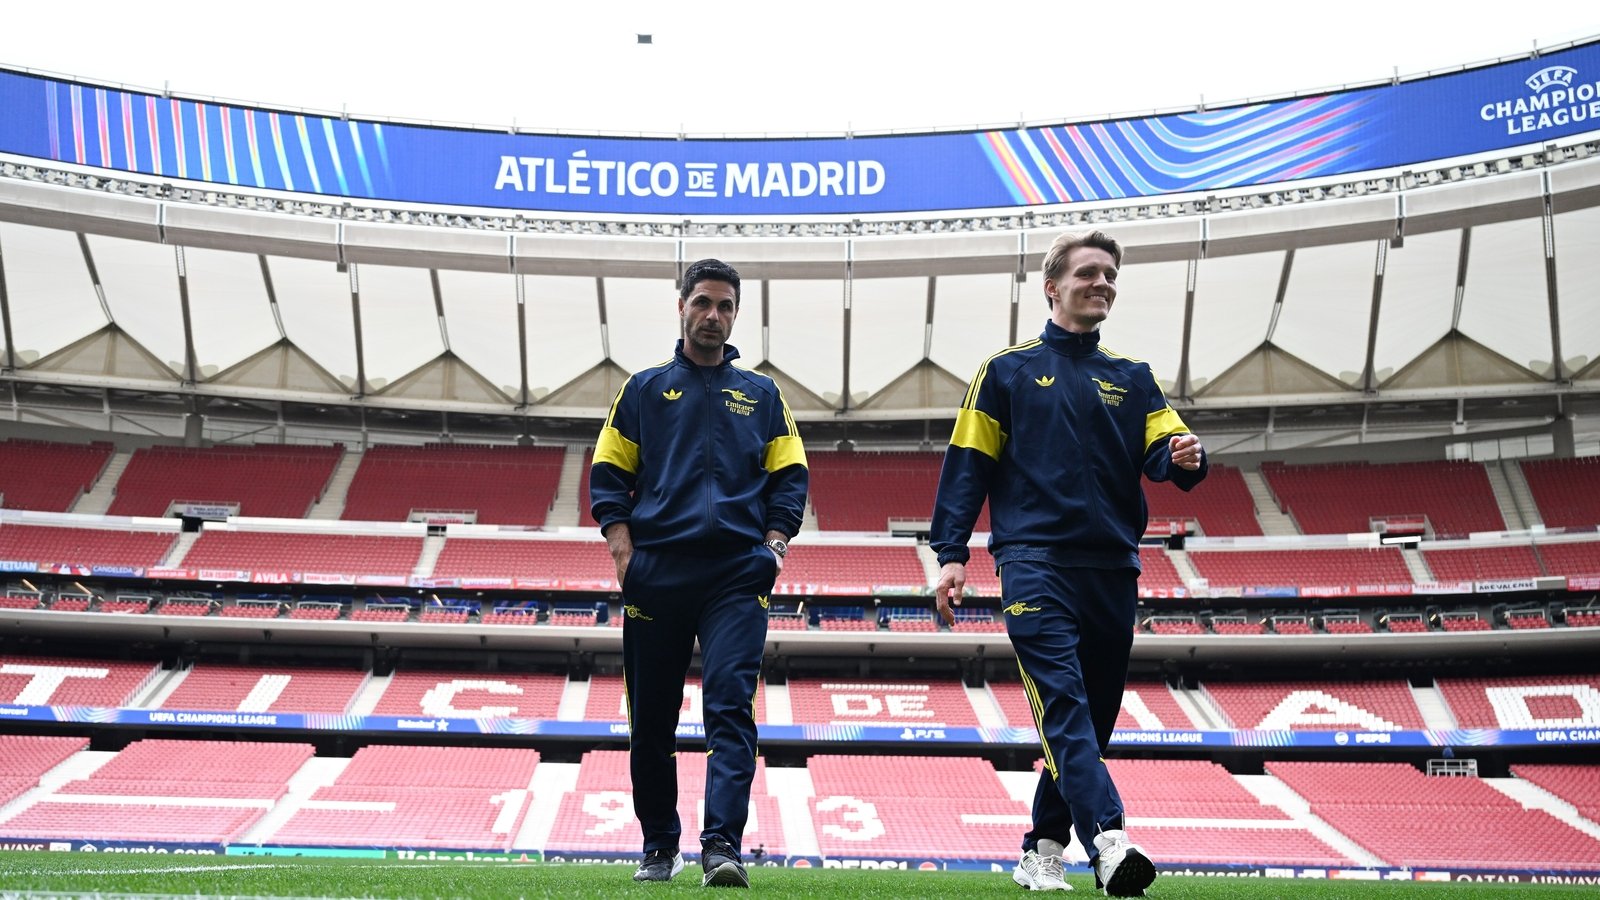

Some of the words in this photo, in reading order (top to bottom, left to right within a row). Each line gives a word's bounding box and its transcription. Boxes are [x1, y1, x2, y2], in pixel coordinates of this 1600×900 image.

[1528, 69, 1573, 90] UEFA
[1507, 101, 1600, 135] LEAGUE
[494, 149, 679, 198] ATLÉTICO
[688, 169, 715, 190] DE
[724, 160, 886, 198] MADRID
[725, 400, 755, 412] Emirates
[253, 572, 288, 583] AVILA
[149, 712, 175, 723] UEFA
[177, 713, 237, 724] CHAMPIONS
[238, 714, 277, 725] LEAGUE
[916, 729, 946, 739] PS5
[1110, 732, 1161, 743] HAMPIONS
[1163, 733, 1203, 743] LEAGUE
[1355, 733, 1391, 743] PEPSI
[1536, 731, 1568, 741] UEFA
